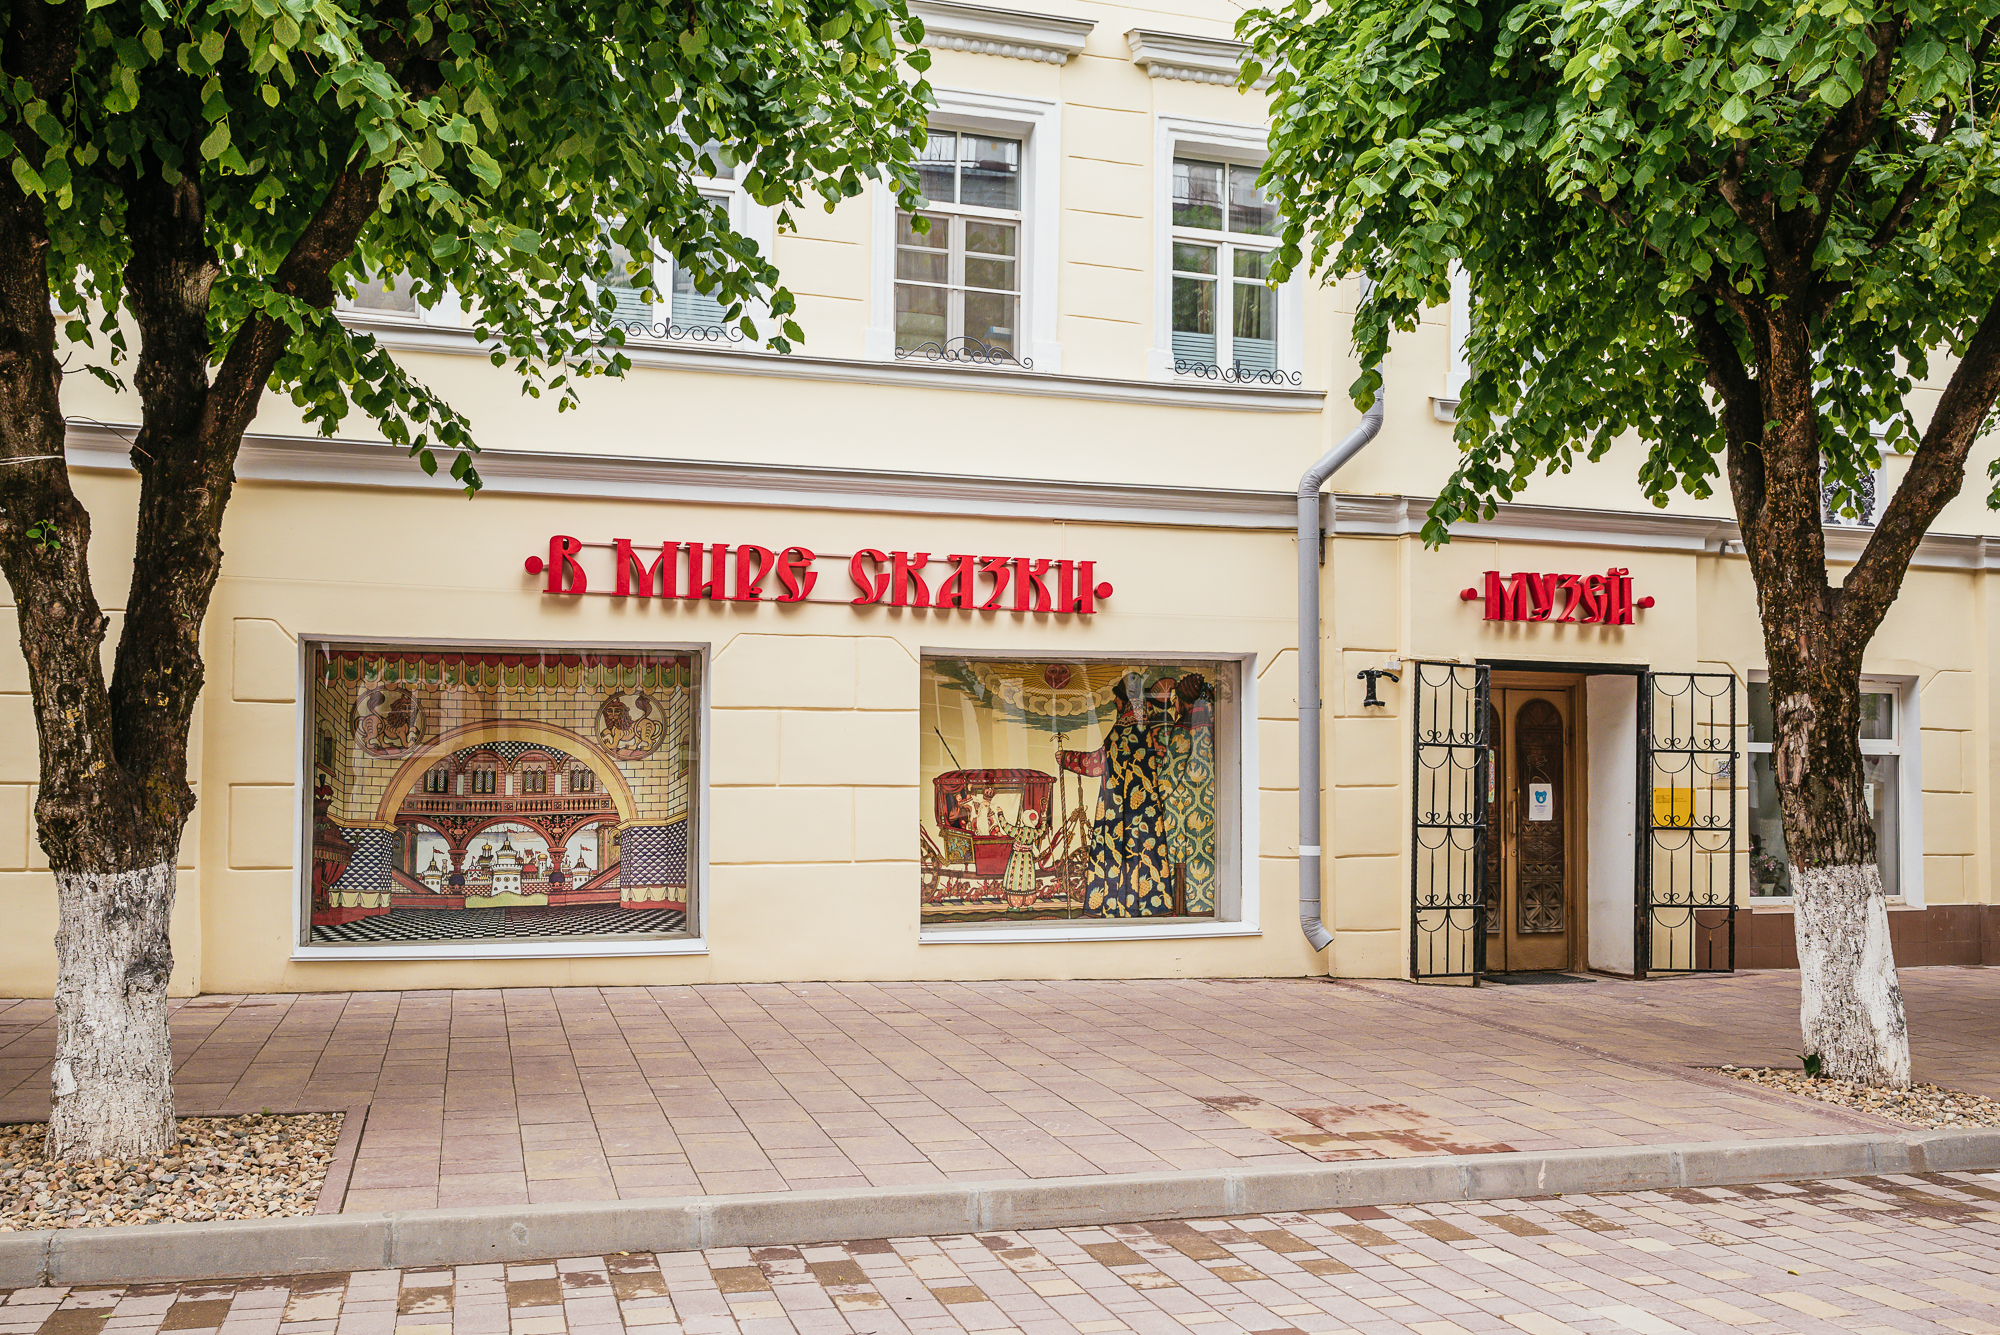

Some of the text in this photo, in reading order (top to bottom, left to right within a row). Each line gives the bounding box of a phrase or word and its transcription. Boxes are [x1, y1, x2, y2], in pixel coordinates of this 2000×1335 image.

[543, 535, 1098, 614] В МИРЕ СКАЗКИ
[1482, 567, 1635, 625] МУЗЕЙ
